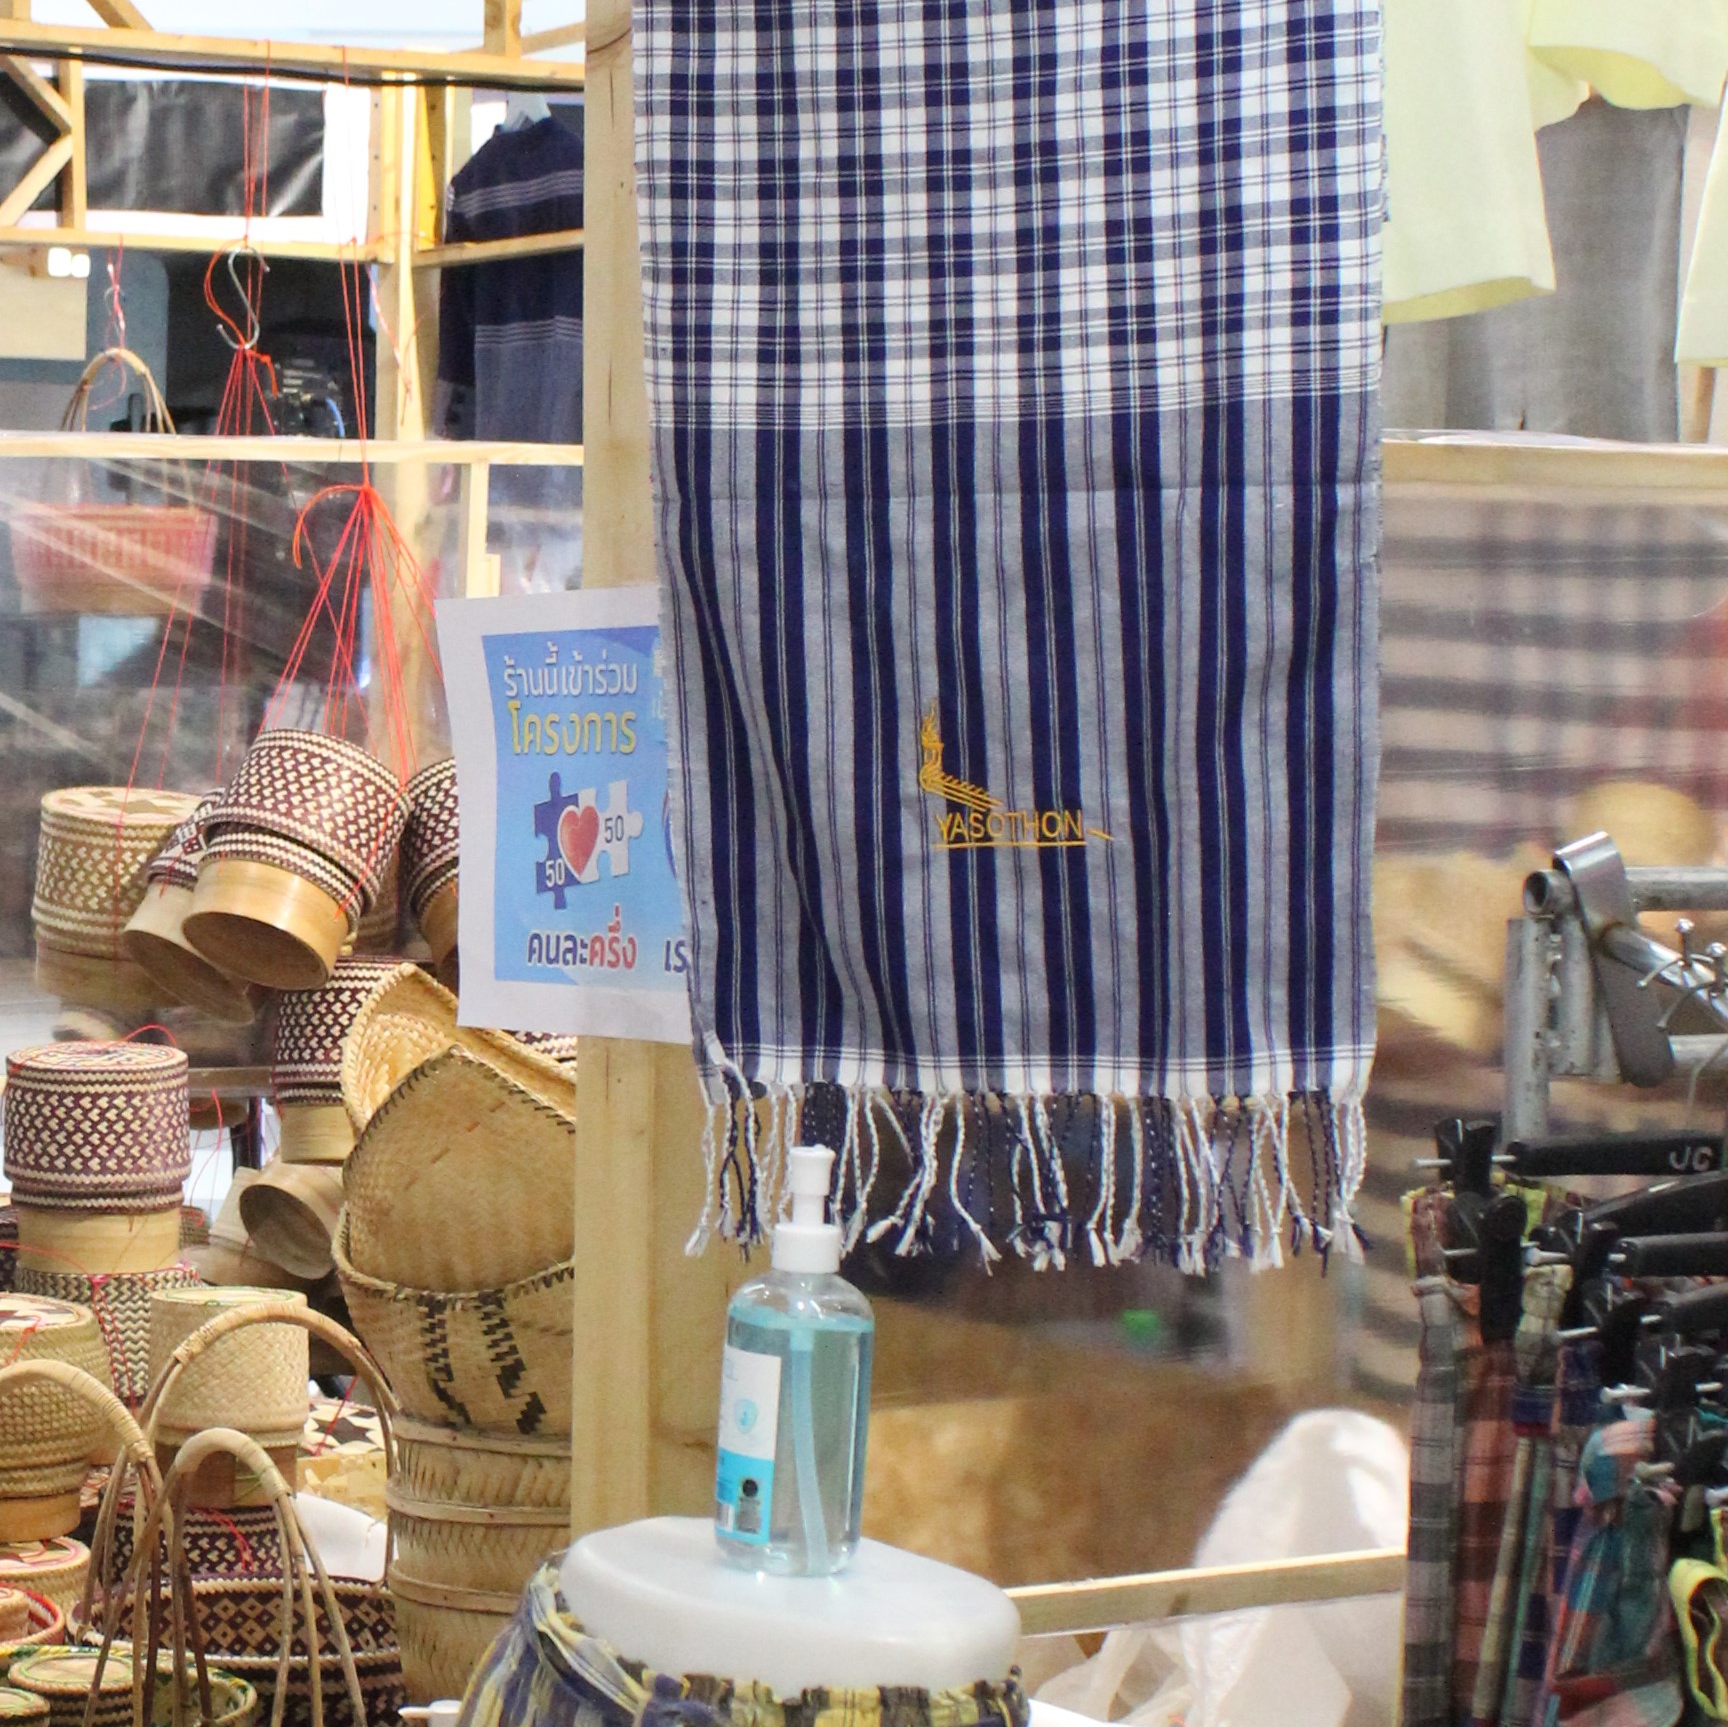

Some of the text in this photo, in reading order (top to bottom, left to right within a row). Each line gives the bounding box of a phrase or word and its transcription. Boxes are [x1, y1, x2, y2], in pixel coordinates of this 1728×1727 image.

[506, 700, 637, 755] โครงการ
[604, 815, 625, 844] 50
[935, 809, 1084, 844] YASOTHON
[545, 859, 566, 888] 50
[527, 903, 638, 971] คนละครึ่ง
